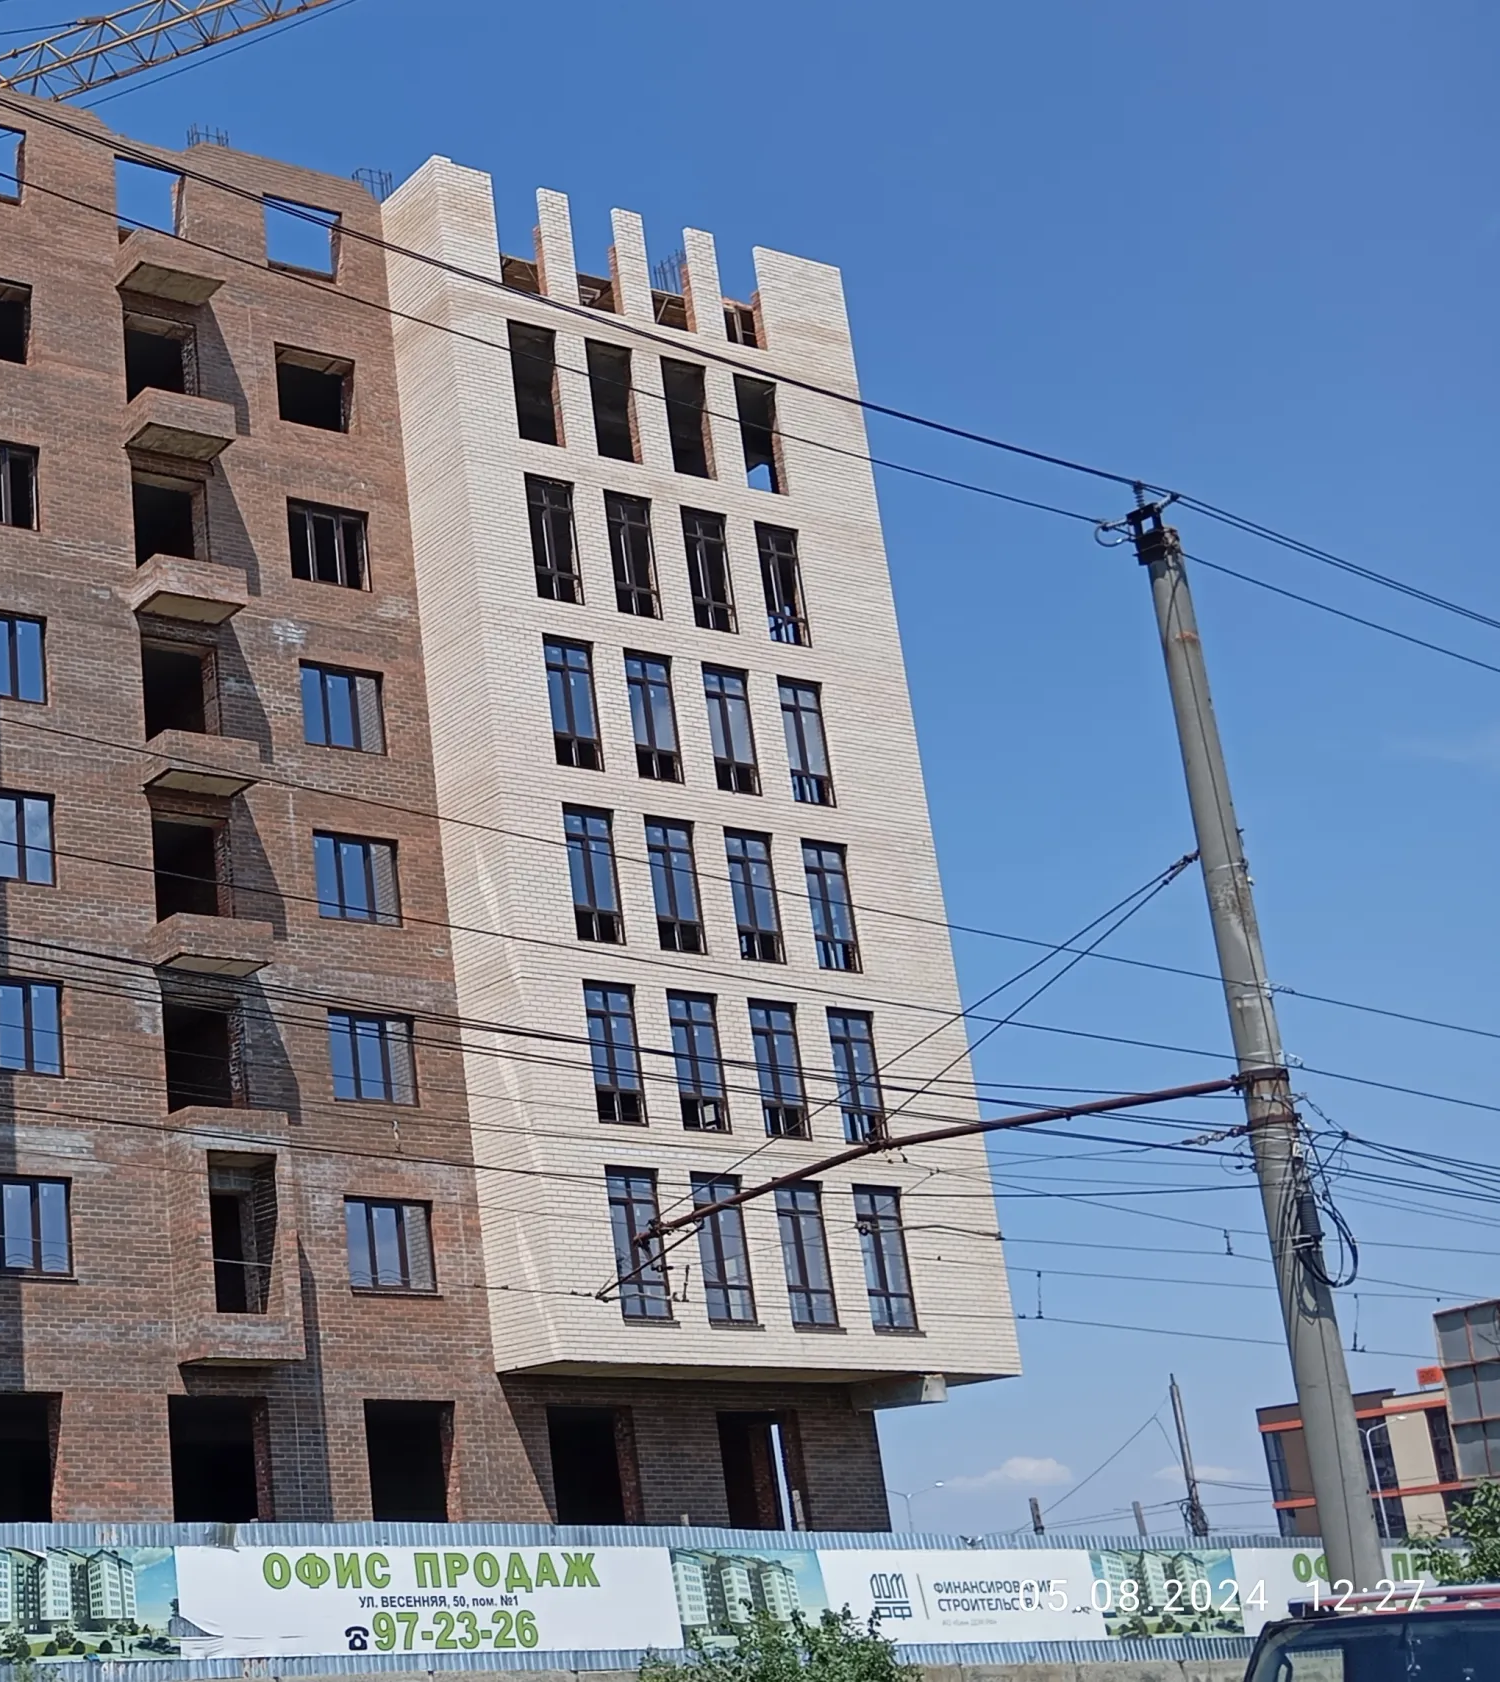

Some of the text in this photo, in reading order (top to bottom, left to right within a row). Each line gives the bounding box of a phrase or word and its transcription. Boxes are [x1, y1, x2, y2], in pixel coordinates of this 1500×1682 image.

[263, 1552, 601, 1593] ОФИС ПРОДАЖ
[870, 1573, 908, 1599] ДОМ
[359, 1594, 519, 1610] УЛ. ВЕСЕННЯЯ, 50, пом. №1
[874, 1606, 912, 1621] РФ
[372, 1610, 539, 1651] 97-23-26
